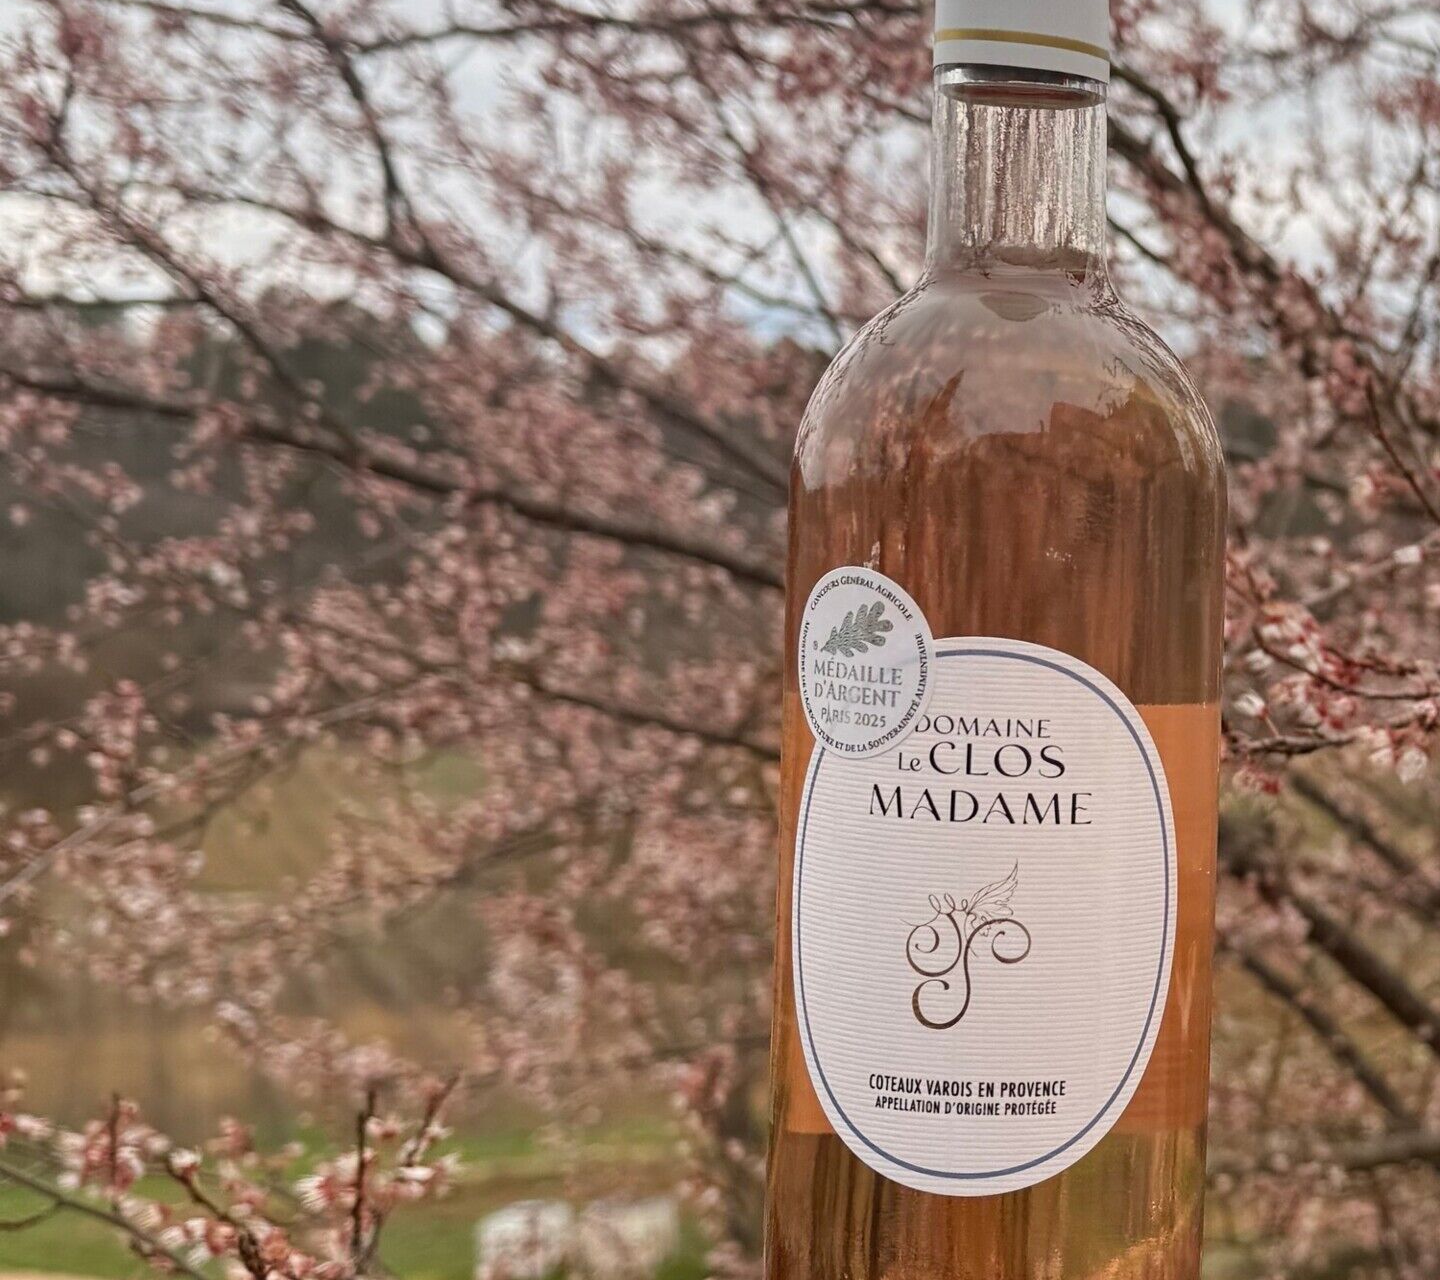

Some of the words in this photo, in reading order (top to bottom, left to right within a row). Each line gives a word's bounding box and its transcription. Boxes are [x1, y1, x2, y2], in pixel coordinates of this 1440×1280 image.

[875, 584, 913, 622] AGRICOLE
[813, 656, 903, 686] MÉDAILLE
[814, 681, 901, 708] D'ARGENT
[820, 703, 851, 725] PARIS
[854, 711, 886, 728] 2025
[915, 714, 1051, 739] DOMAINE
[845, 741, 856, 752] DE
[857, 741, 867, 752] LA
[898, 752, 921, 772] Le
[929, 741, 1066, 778] CLOS
[870, 783, 1092, 825] MADAME
[869, 1073, 922, 1094] COTEAUX
[926, 1080, 973, 1097] VAROIS
[978, 1082, 994, 1098] EN
[1000, 1080, 1066, 1098] PROVENCE
[875, 1095, 941, 1114] APPELLATION
[944, 1101, 1000, 1116] D'ORIGINE
[1004, 1099, 1057, 1116] PROTÉGÉE
